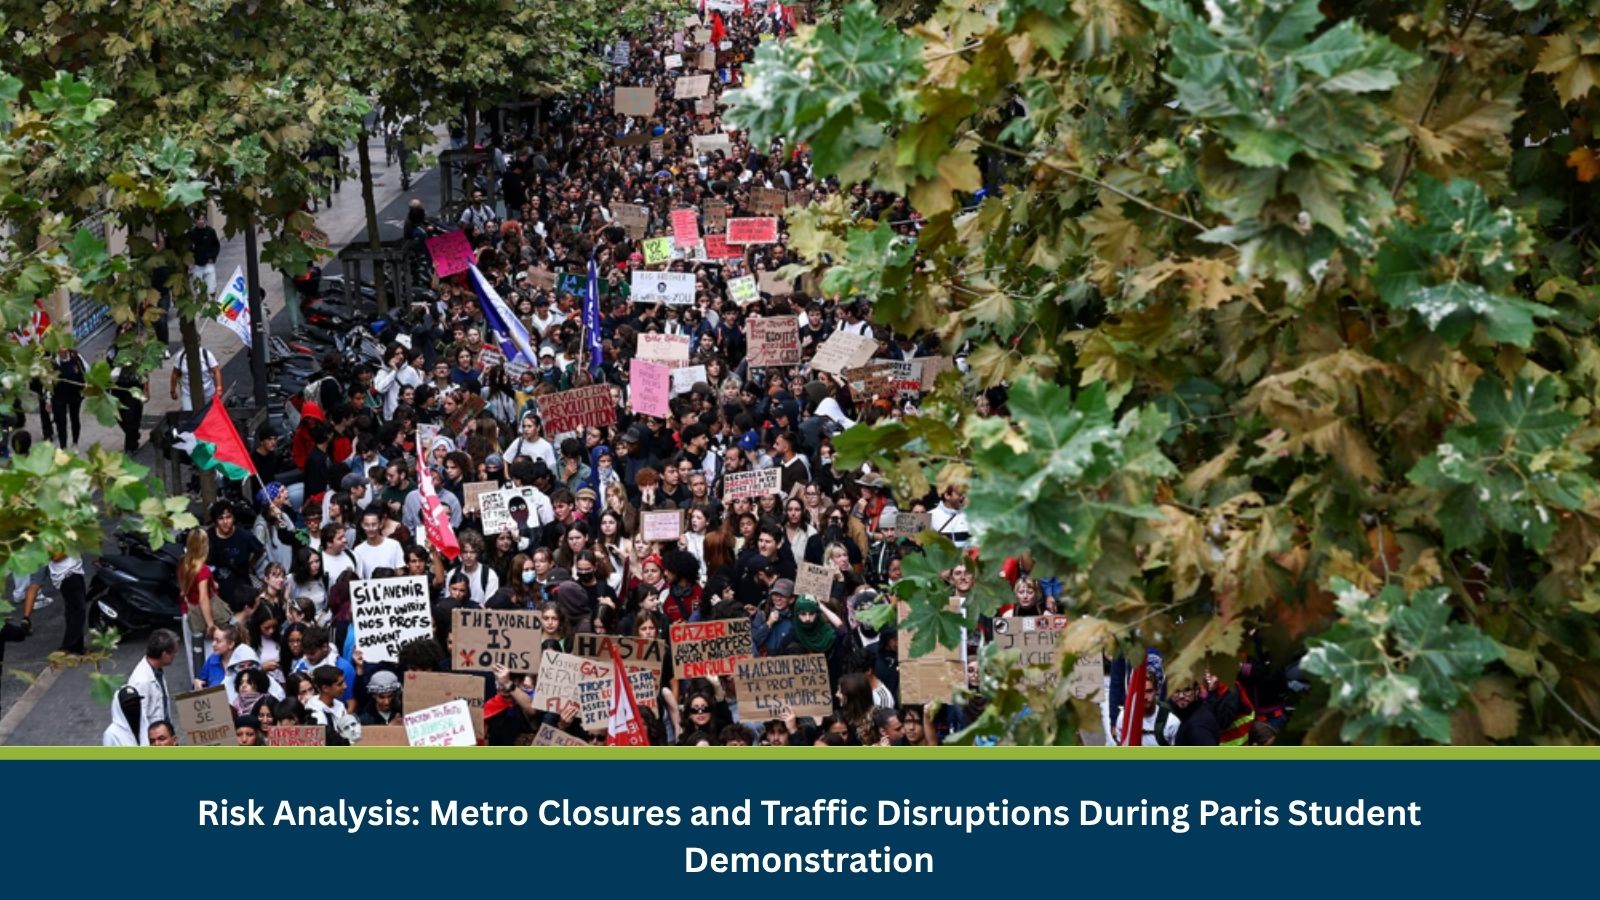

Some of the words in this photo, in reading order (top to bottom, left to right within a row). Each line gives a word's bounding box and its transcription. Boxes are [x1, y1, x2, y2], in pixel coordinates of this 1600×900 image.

[672, 292, 692, 302] YOU
[372, 580, 424, 601] L'AVENIR
[356, 602, 391, 617] AVAIT
[358, 618, 383, 630] NOS
[389, 615, 431, 629] PROFS
[461, 611, 492, 628] THE
[496, 613, 541, 630] WORLD
[358, 630, 402, 647] SERAIENT
[487, 629, 511, 649] IS
[671, 622, 726, 643] GAZER
[728, 620, 751, 634] NOUS
[579, 635, 662, 662] HASTA
[677, 643, 699, 655] AUX
[701, 634, 752, 652] POPPERS
[675, 653, 703, 667] POUR
[738, 659, 790, 679] MACRON
[793, 656, 826, 674] BAISE
[766, 677, 795, 691] PROF
[801, 674, 827, 686] PAS
[194, 699, 211, 711] ON
[755, 694, 782, 709] LES
[196, 712, 214, 724] SE
[187, 725, 229, 745] TRUMP
